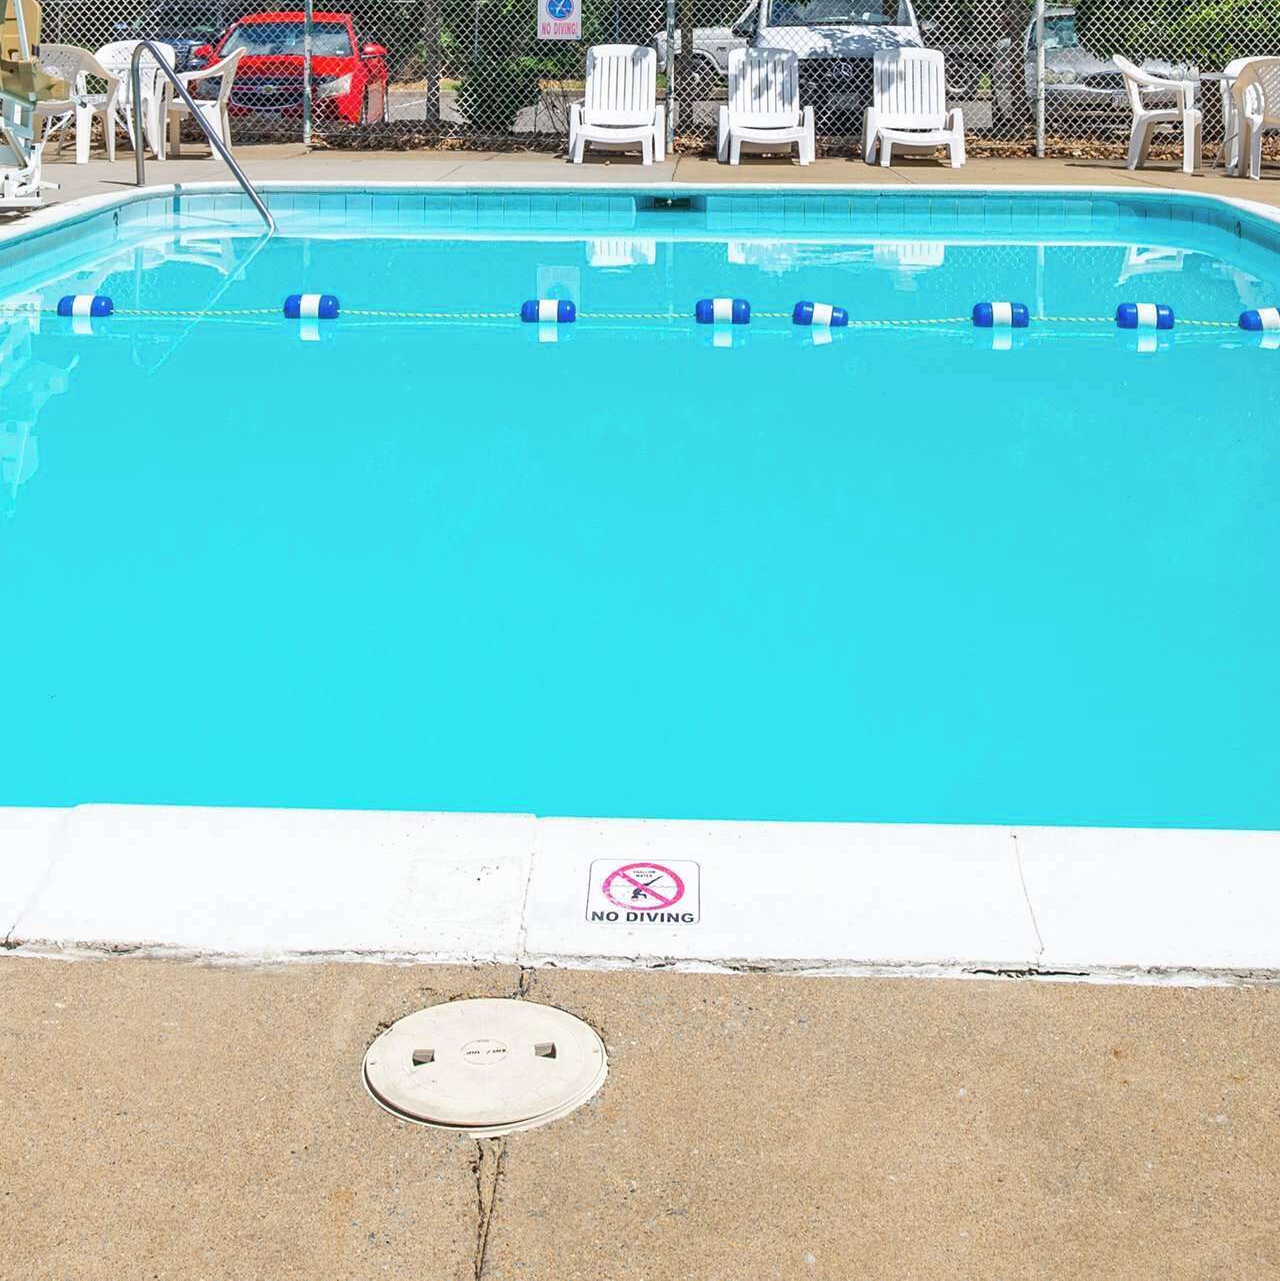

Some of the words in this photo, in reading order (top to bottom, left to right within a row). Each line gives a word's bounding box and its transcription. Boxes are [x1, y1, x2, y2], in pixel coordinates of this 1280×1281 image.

[541, 23, 552, 35] NO
[591, 911, 619, 922] NO
[626, 911, 695, 923] DIVING
